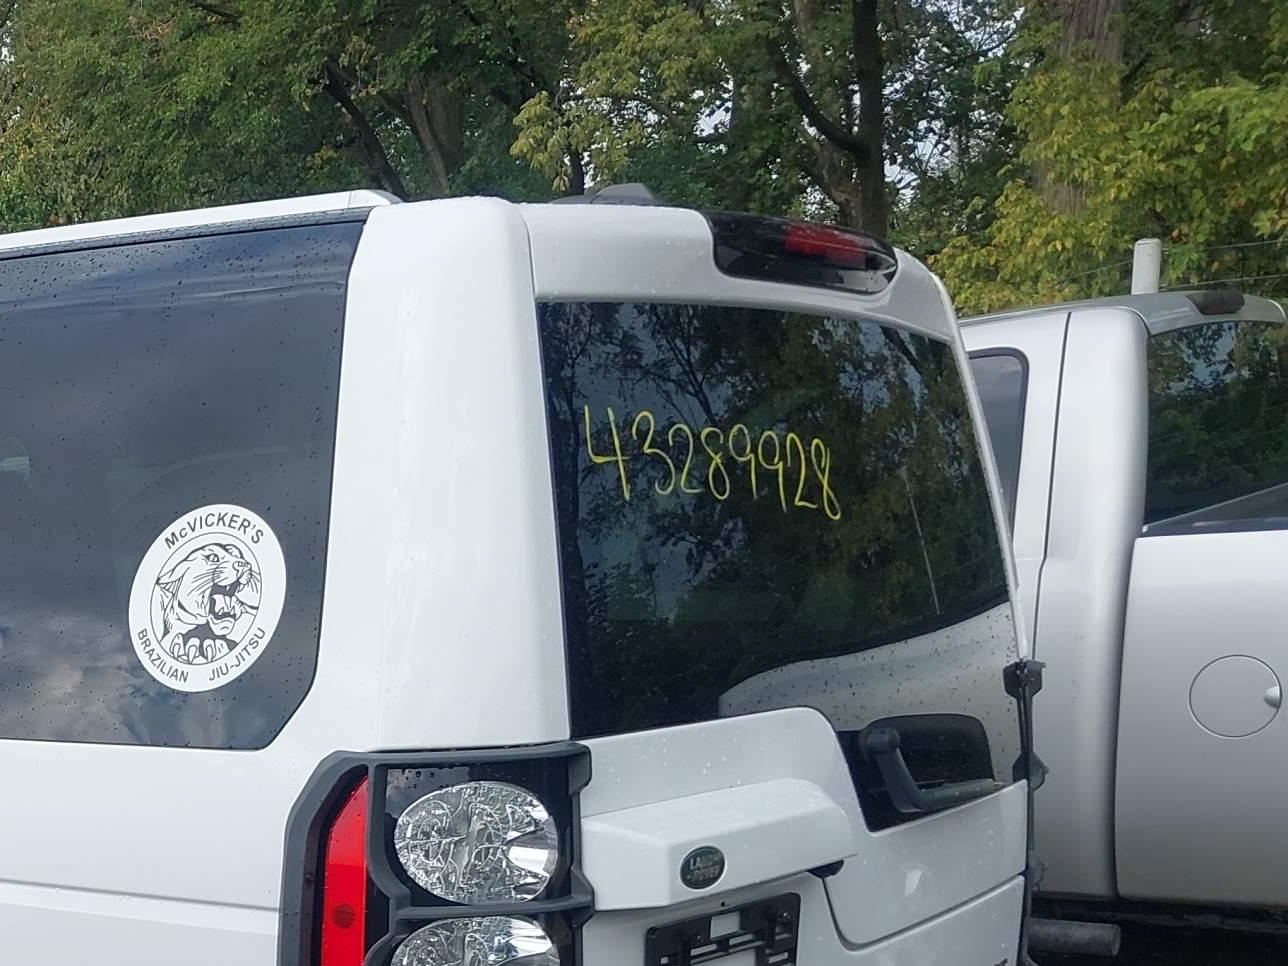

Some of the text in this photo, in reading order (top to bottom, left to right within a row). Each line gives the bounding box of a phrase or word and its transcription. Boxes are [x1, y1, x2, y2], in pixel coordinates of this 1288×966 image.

[583, 404, 842, 521] 43289928
[163, 511, 265, 550] McVICKER'S
[137, 626, 266, 684] BRAZILIAN JIU-JITSU
